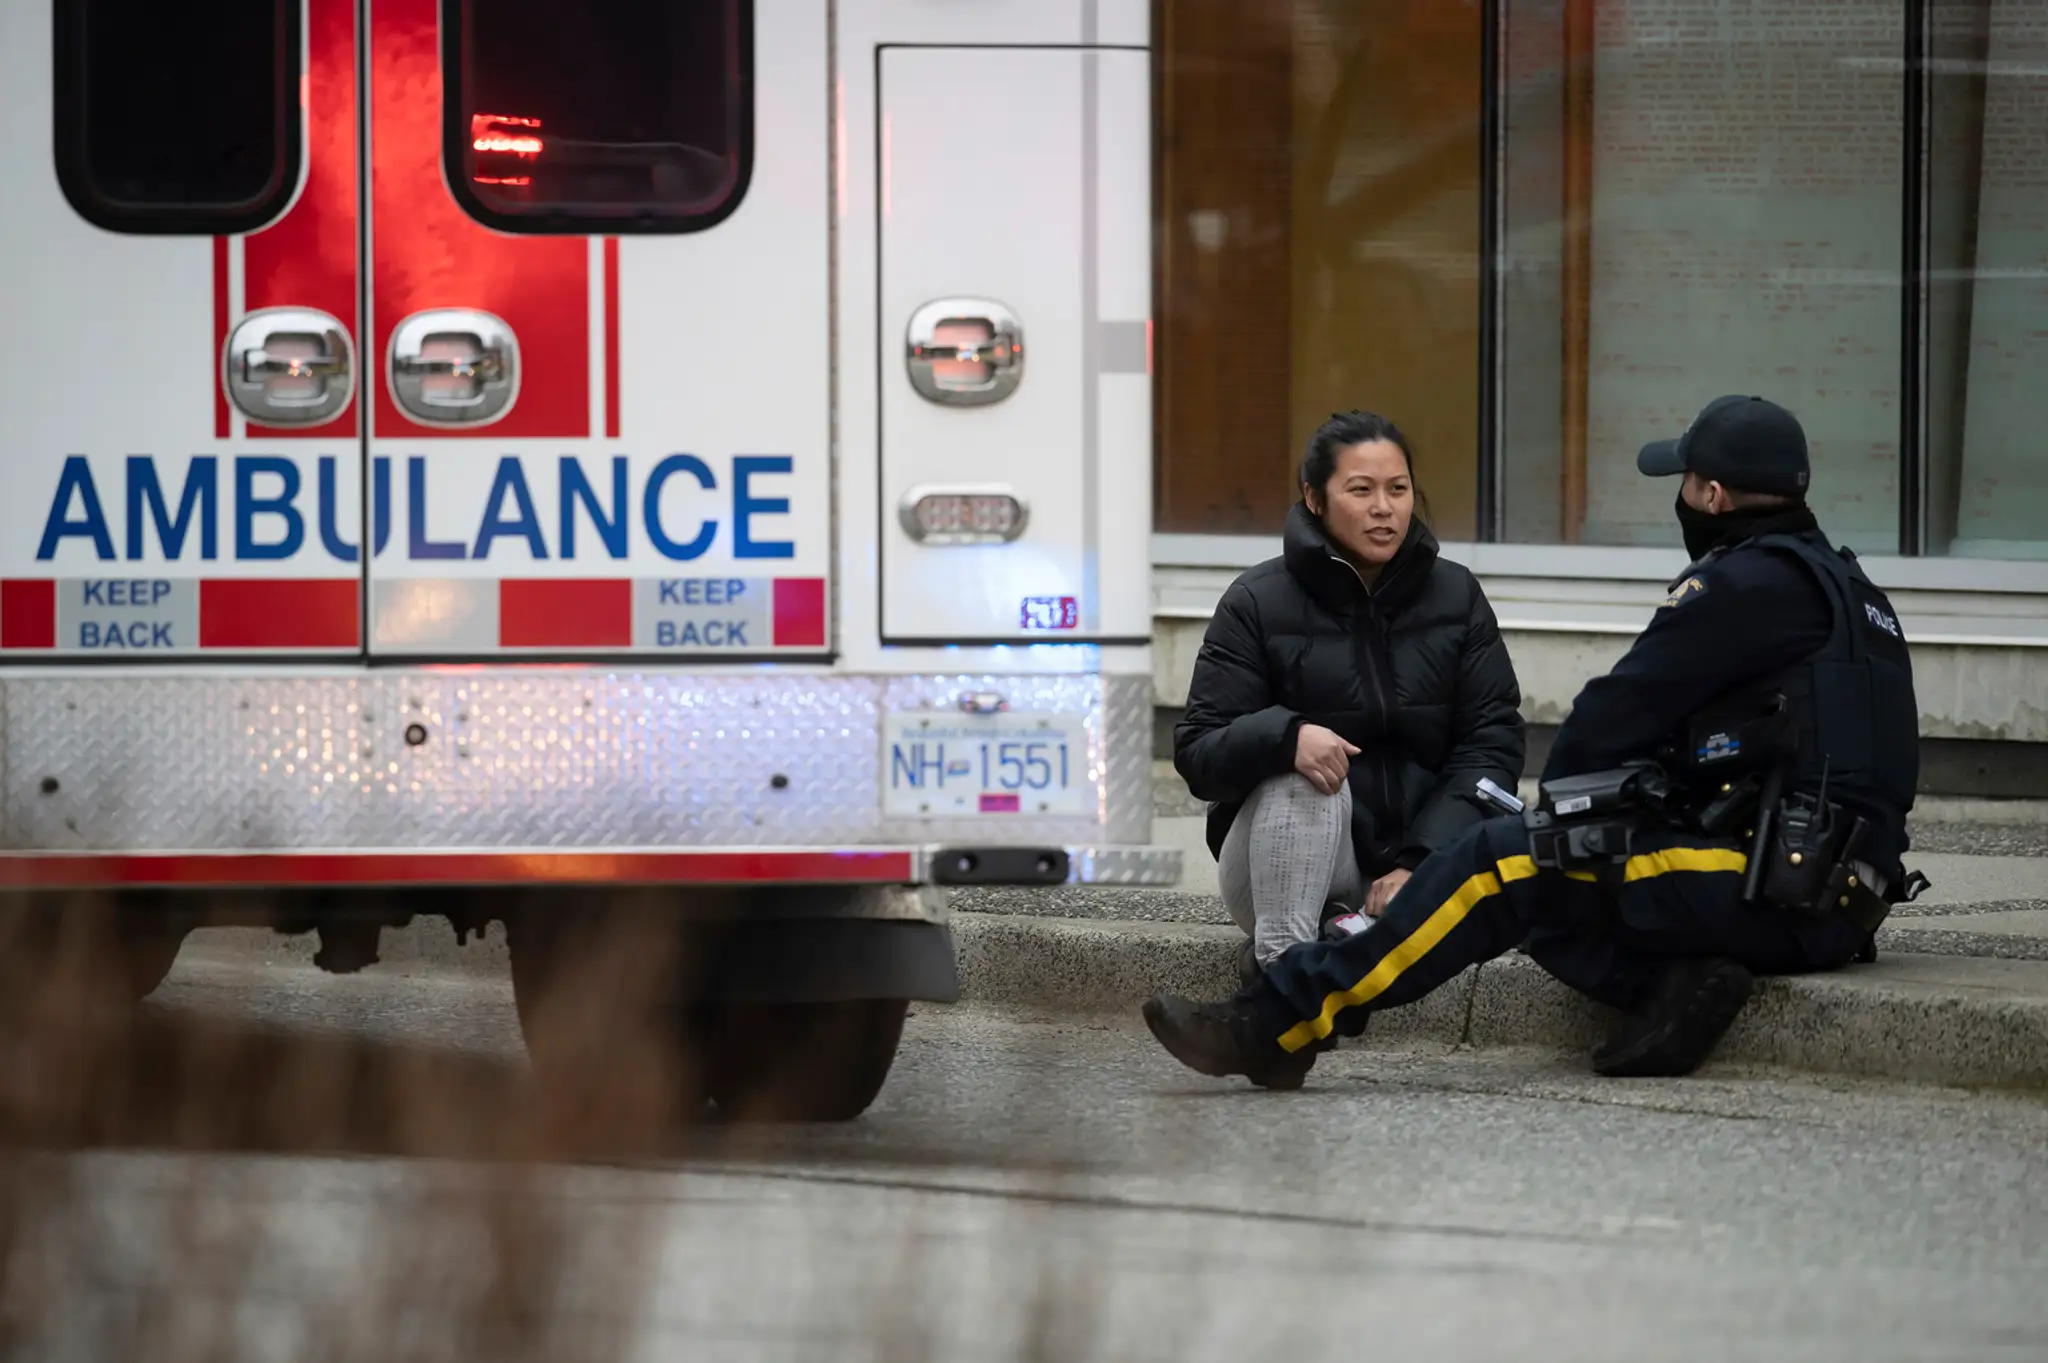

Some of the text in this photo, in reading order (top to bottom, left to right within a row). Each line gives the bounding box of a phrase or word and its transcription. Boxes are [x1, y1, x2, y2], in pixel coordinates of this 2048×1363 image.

[35, 454, 796, 561] AMBULANCE
[84, 580, 171, 605] KEEP
[659, 579, 746, 604] KEEP
[1864, 603, 1898, 636] POLICE
[80, 621, 173, 648] BACK
[657, 620, 749, 647] BACK
